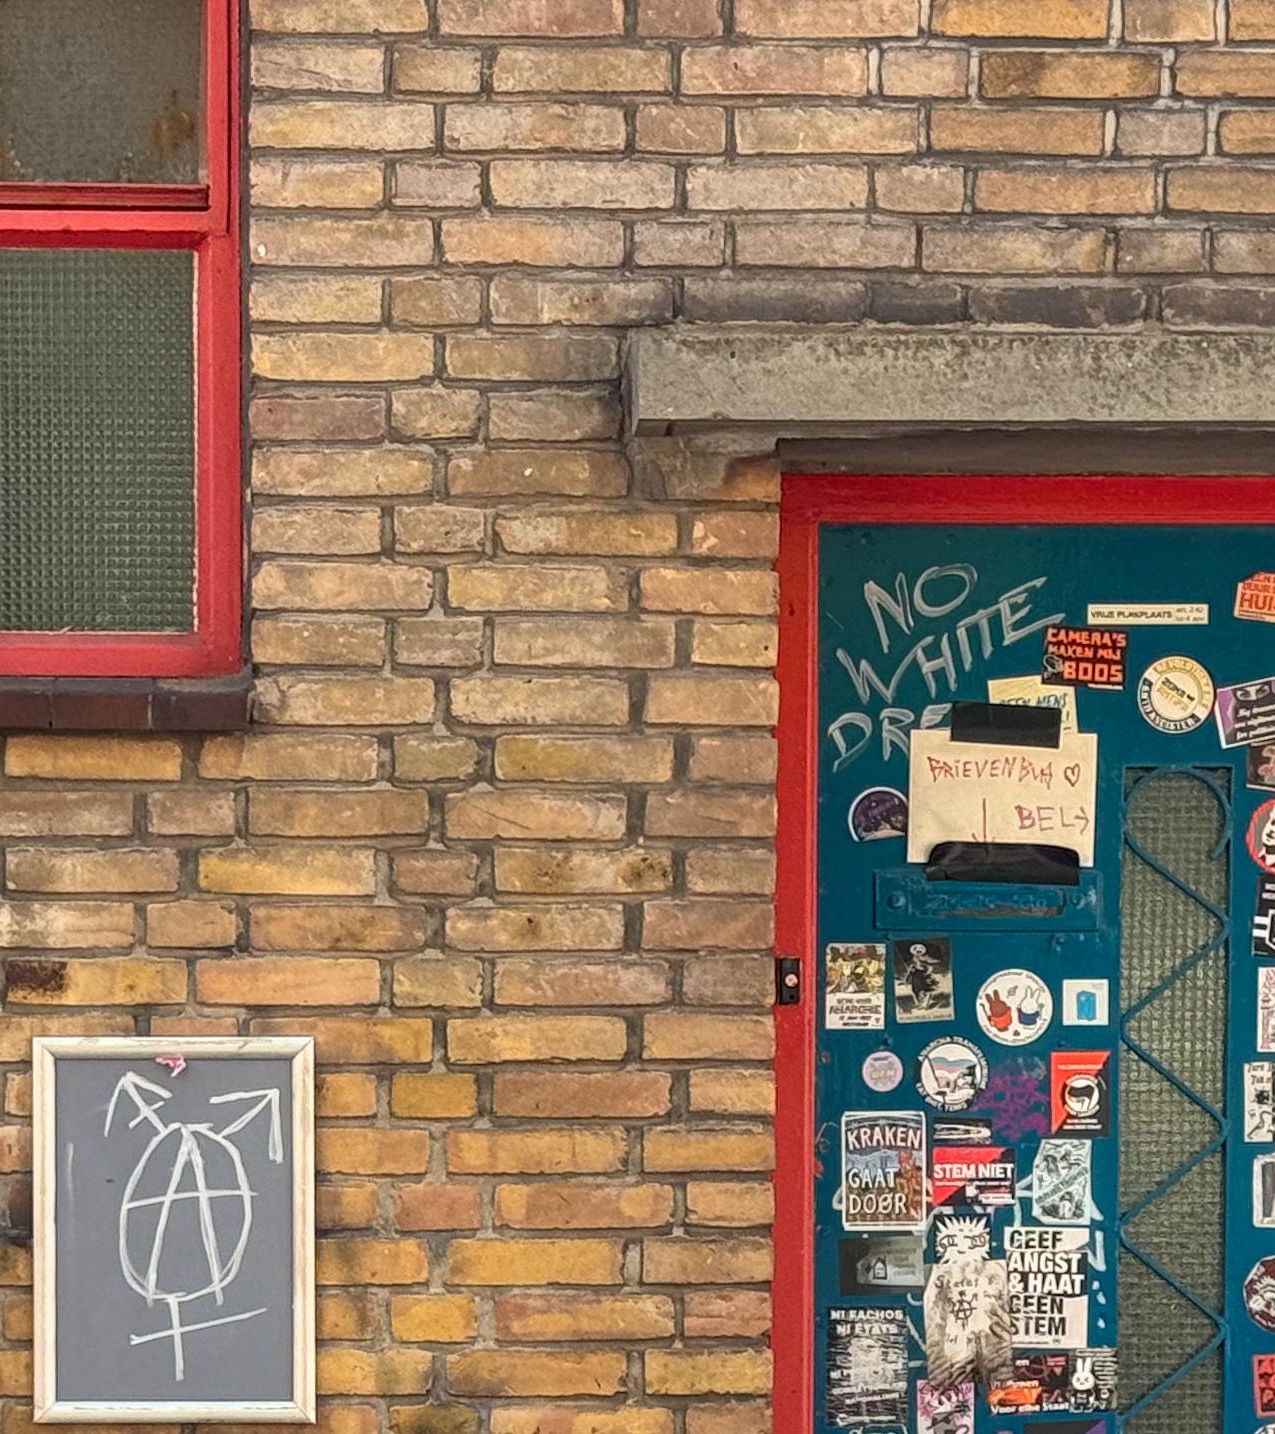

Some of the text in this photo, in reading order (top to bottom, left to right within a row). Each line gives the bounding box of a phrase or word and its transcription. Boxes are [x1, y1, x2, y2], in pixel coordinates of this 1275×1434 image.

[864, 563, 978, 654] NO
[837, 577, 1064, 702] WHITE
[1046, 627, 1126, 646] CAMERA'S
[1047, 643, 1093, 658] MAKEN
[1063, 662, 1123, 683] BOOS
[1015, 804, 1076, 831] BEL
[847, 1128, 921, 1150] KRAKEN
[848, 1168, 898, 1190] GAAT
[933, 1163, 1014, 1179] STEM NIET
[1010, 1230, 1064, 1250] GEEF
[1008, 1252, 1082, 1273] ANGST
[1008, 1274, 1084, 1295] & HAAT
[848, 1310, 904, 1321] FACHOS
[1010, 1296, 1064, 1315] GEEN
[1010, 1316, 1067, 1337] STEM
